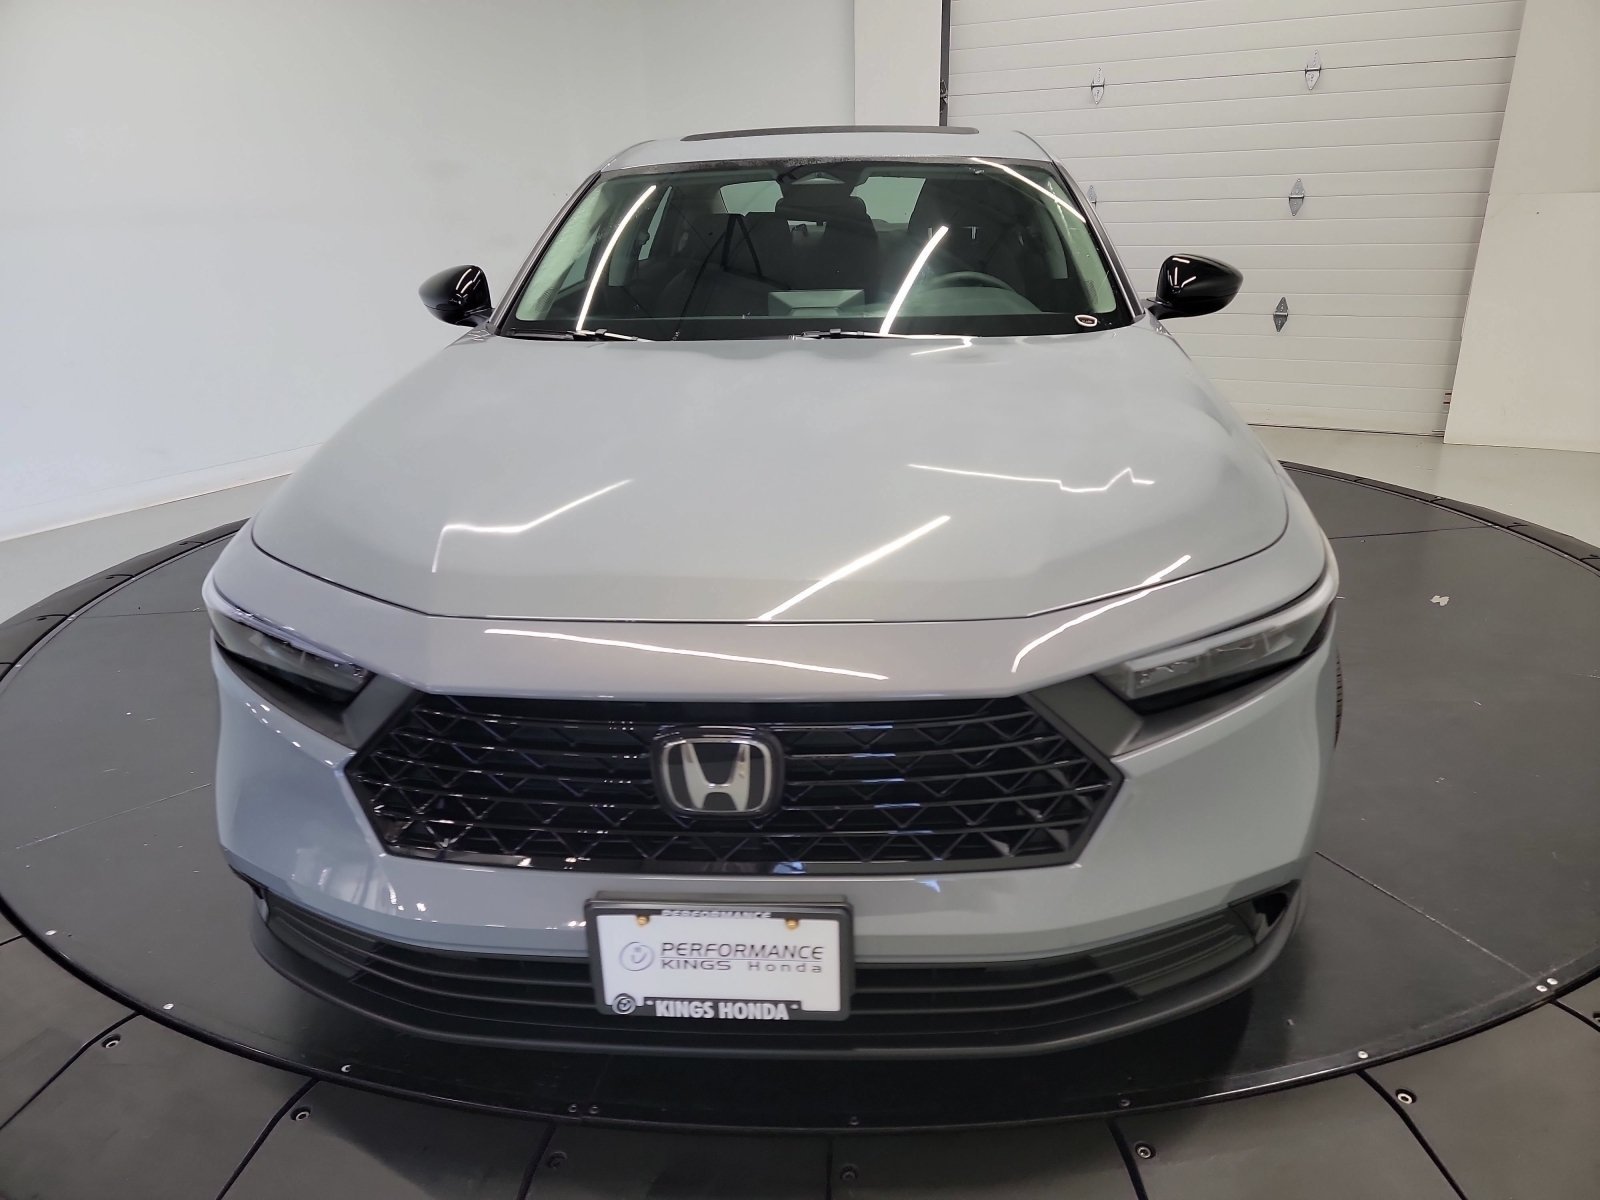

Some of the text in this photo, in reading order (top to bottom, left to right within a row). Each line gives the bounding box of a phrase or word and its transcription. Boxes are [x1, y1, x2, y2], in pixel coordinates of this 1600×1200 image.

[661, 942, 824, 961] PERFORMANCE
[662, 960, 822, 974] KINGS Honda
[655, 1000, 789, 1020] KINGS HONDA
